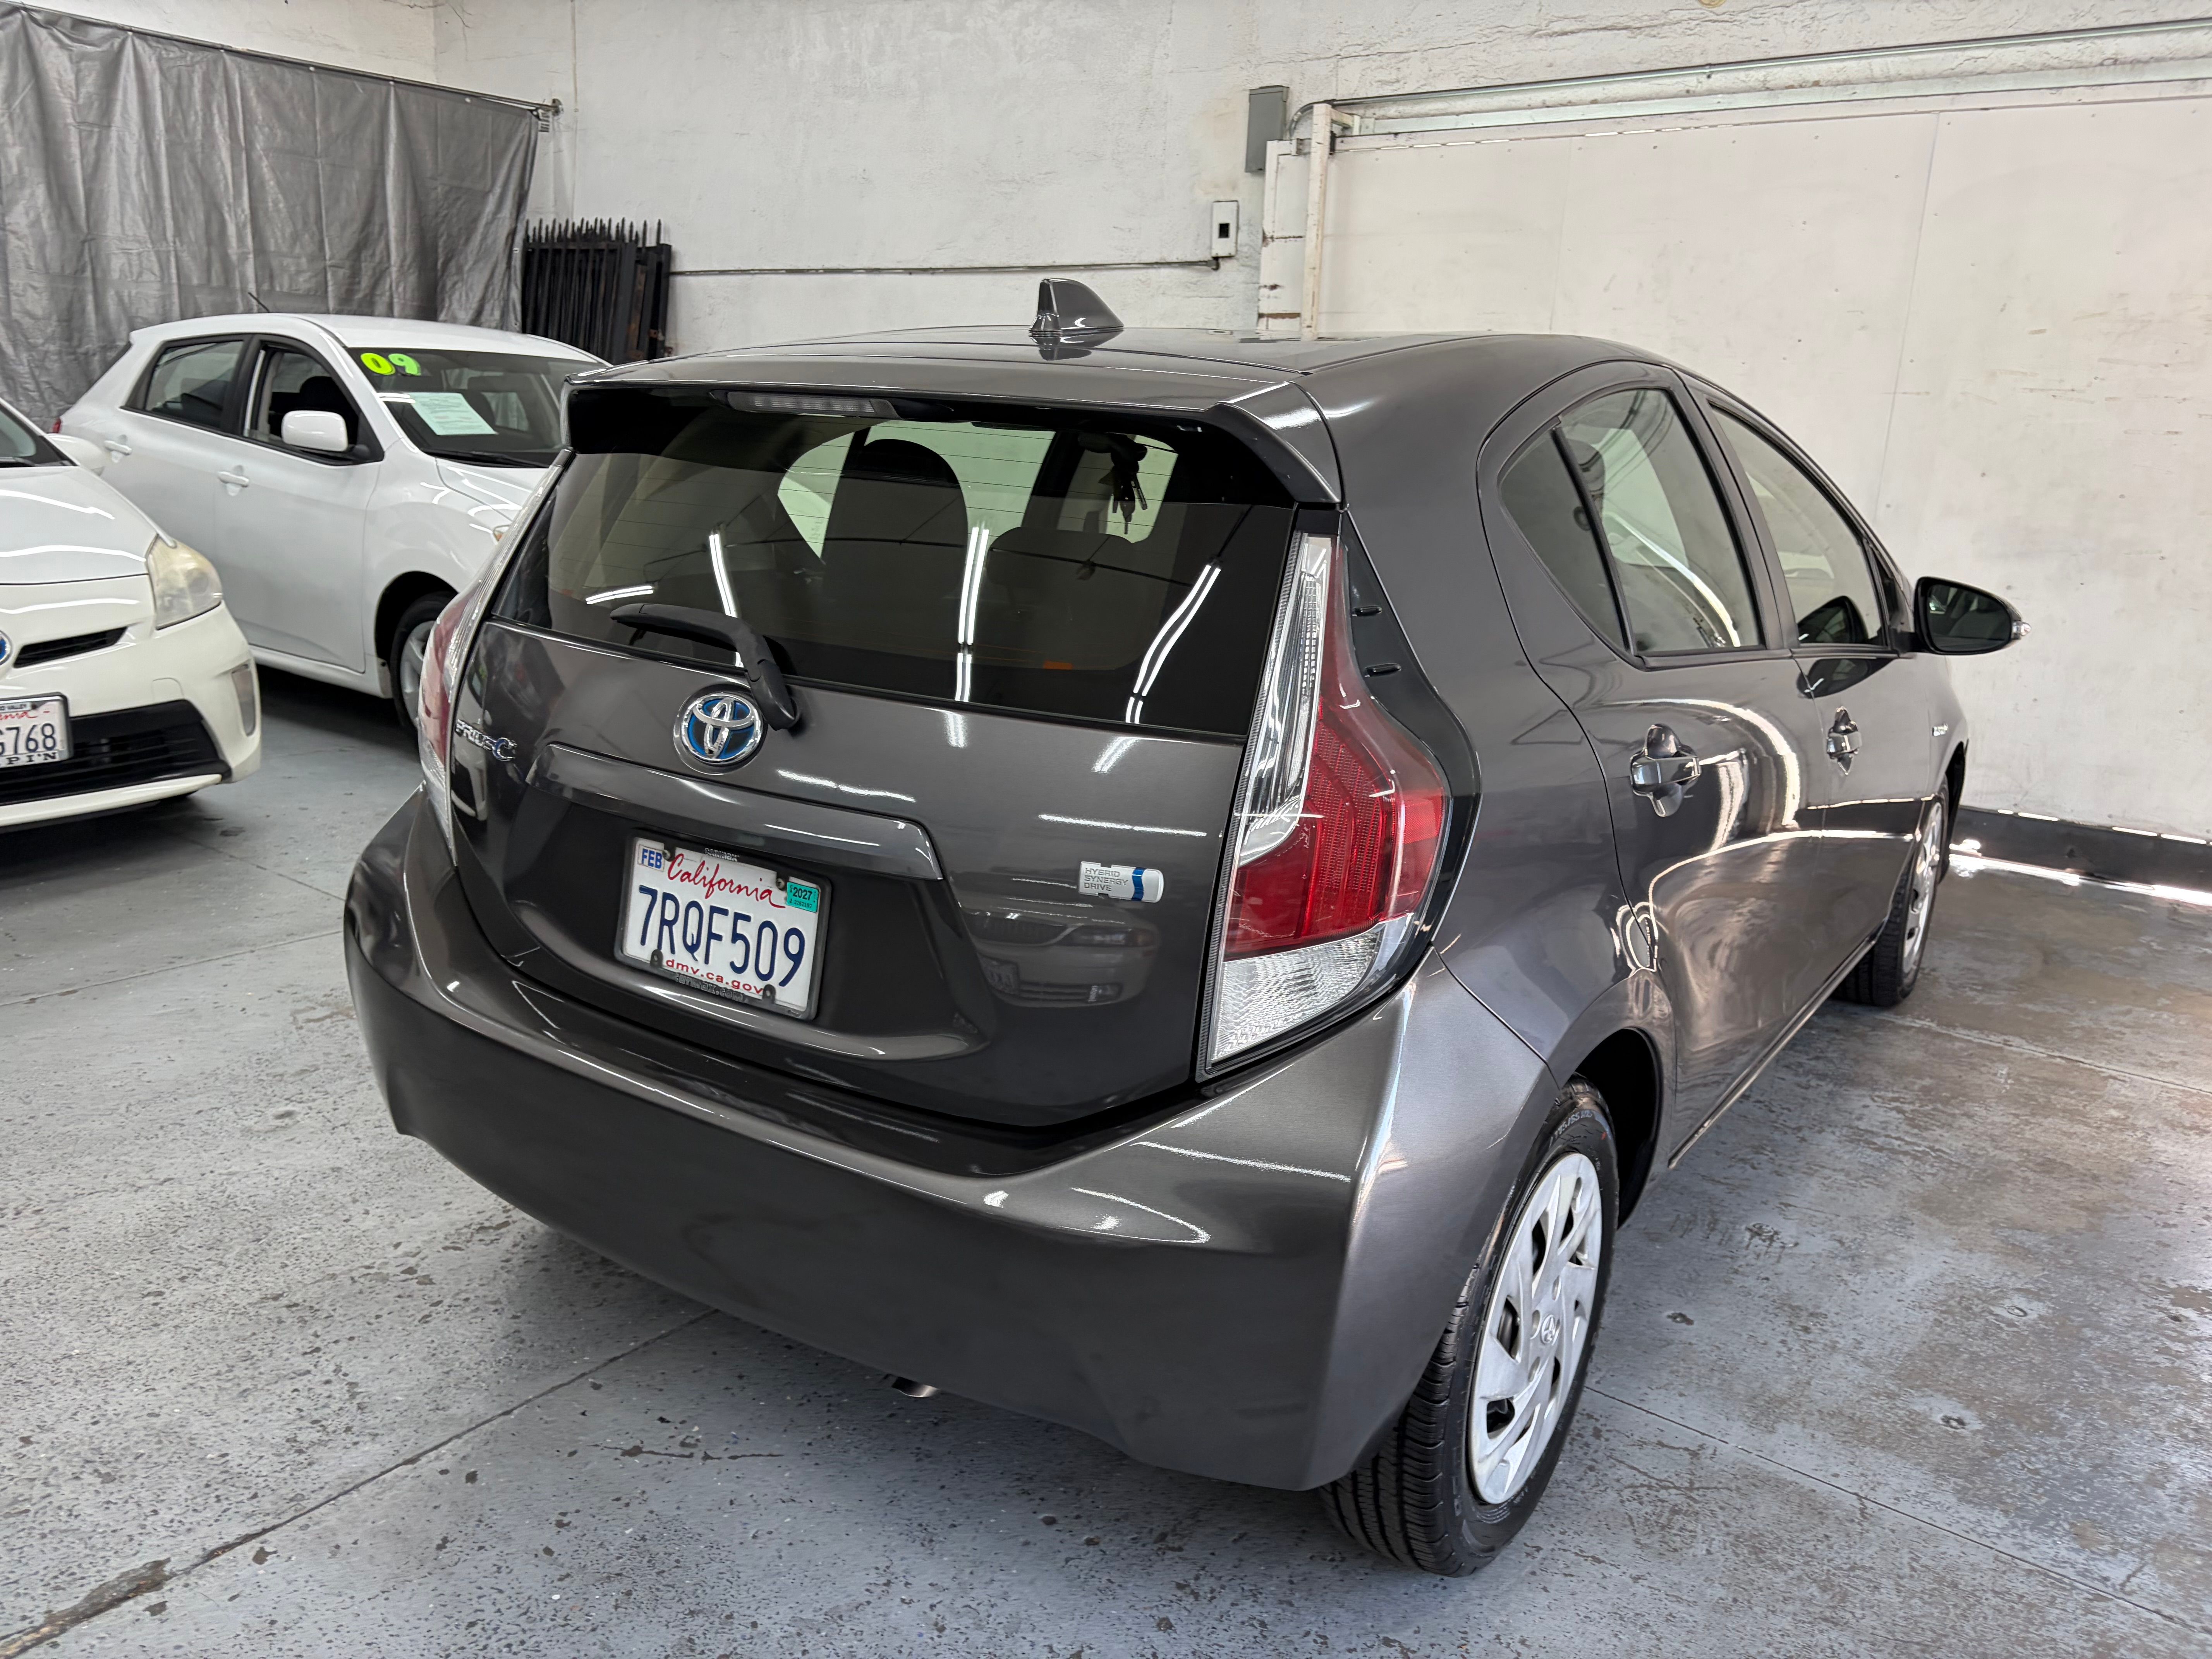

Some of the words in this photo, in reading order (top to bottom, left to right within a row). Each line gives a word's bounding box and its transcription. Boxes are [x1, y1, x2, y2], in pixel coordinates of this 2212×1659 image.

[361, 353, 421, 376] 09
[642, 848, 663, 869] FEB
[668, 853, 786, 908] California
[1084, 875, 1128, 885] SYNERGY
[1085, 868, 1120, 877] HYBRID
[793, 887, 812, 900] 2027
[1084, 883, 1112, 891] DRIVE
[639, 884, 805, 987] 7RQF509
[666, 959, 764, 994] dmv.ca.gov
